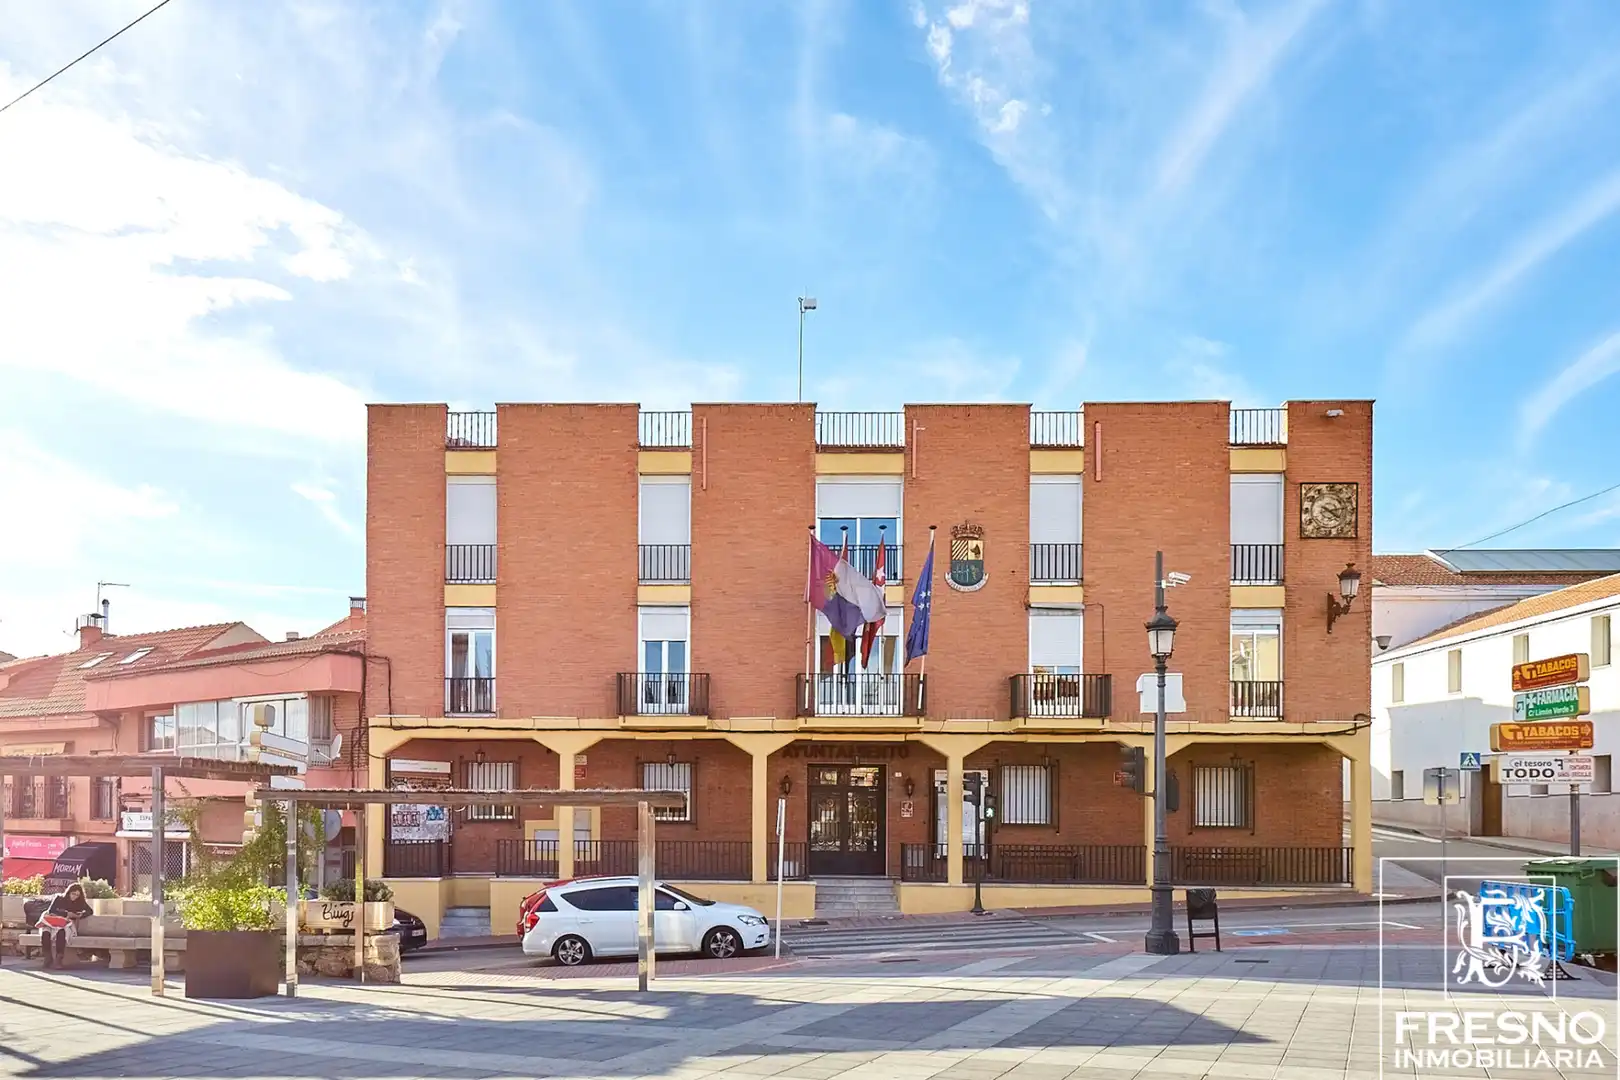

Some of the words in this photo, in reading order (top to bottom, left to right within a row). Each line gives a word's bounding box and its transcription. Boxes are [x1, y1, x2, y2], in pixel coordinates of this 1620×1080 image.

[1536, 657, 1577, 674] TABACOS
[1537, 687, 1578, 705] FARMACIA
[1522, 726, 1579, 737] TABACOS
[782, 744, 910, 760] AYUNTAENTO
[1502, 768, 1555, 778] TODO
